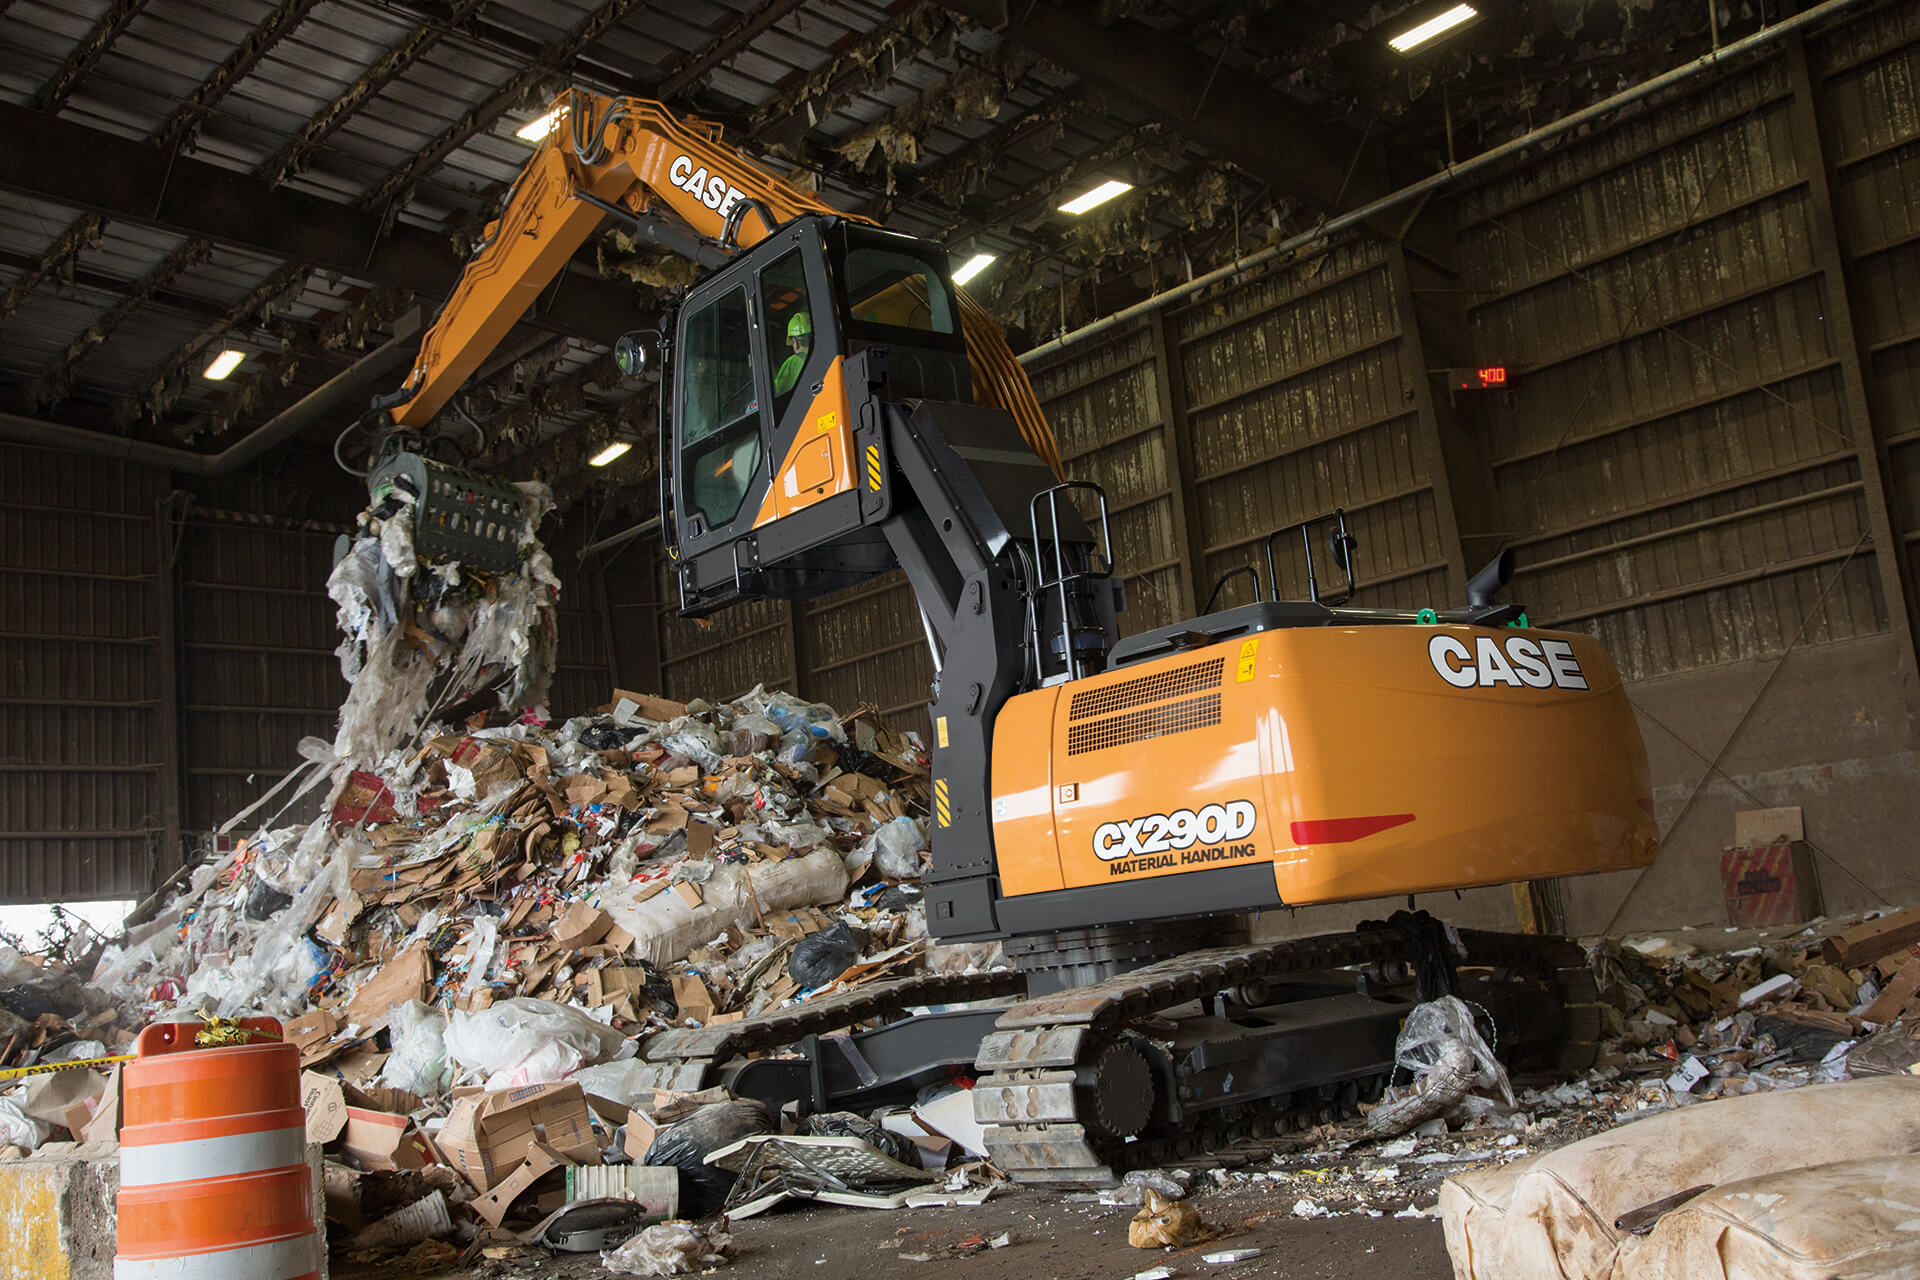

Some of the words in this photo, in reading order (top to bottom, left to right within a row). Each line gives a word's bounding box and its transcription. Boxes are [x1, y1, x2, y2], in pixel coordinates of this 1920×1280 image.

[669, 154, 748, 222] CASE
[1428, 634, 1590, 691] CASE
[1093, 799, 1257, 861] CX290D
[1110, 854, 1178, 876] MATERIAL
[1181, 843, 1256, 865] HANDLING
